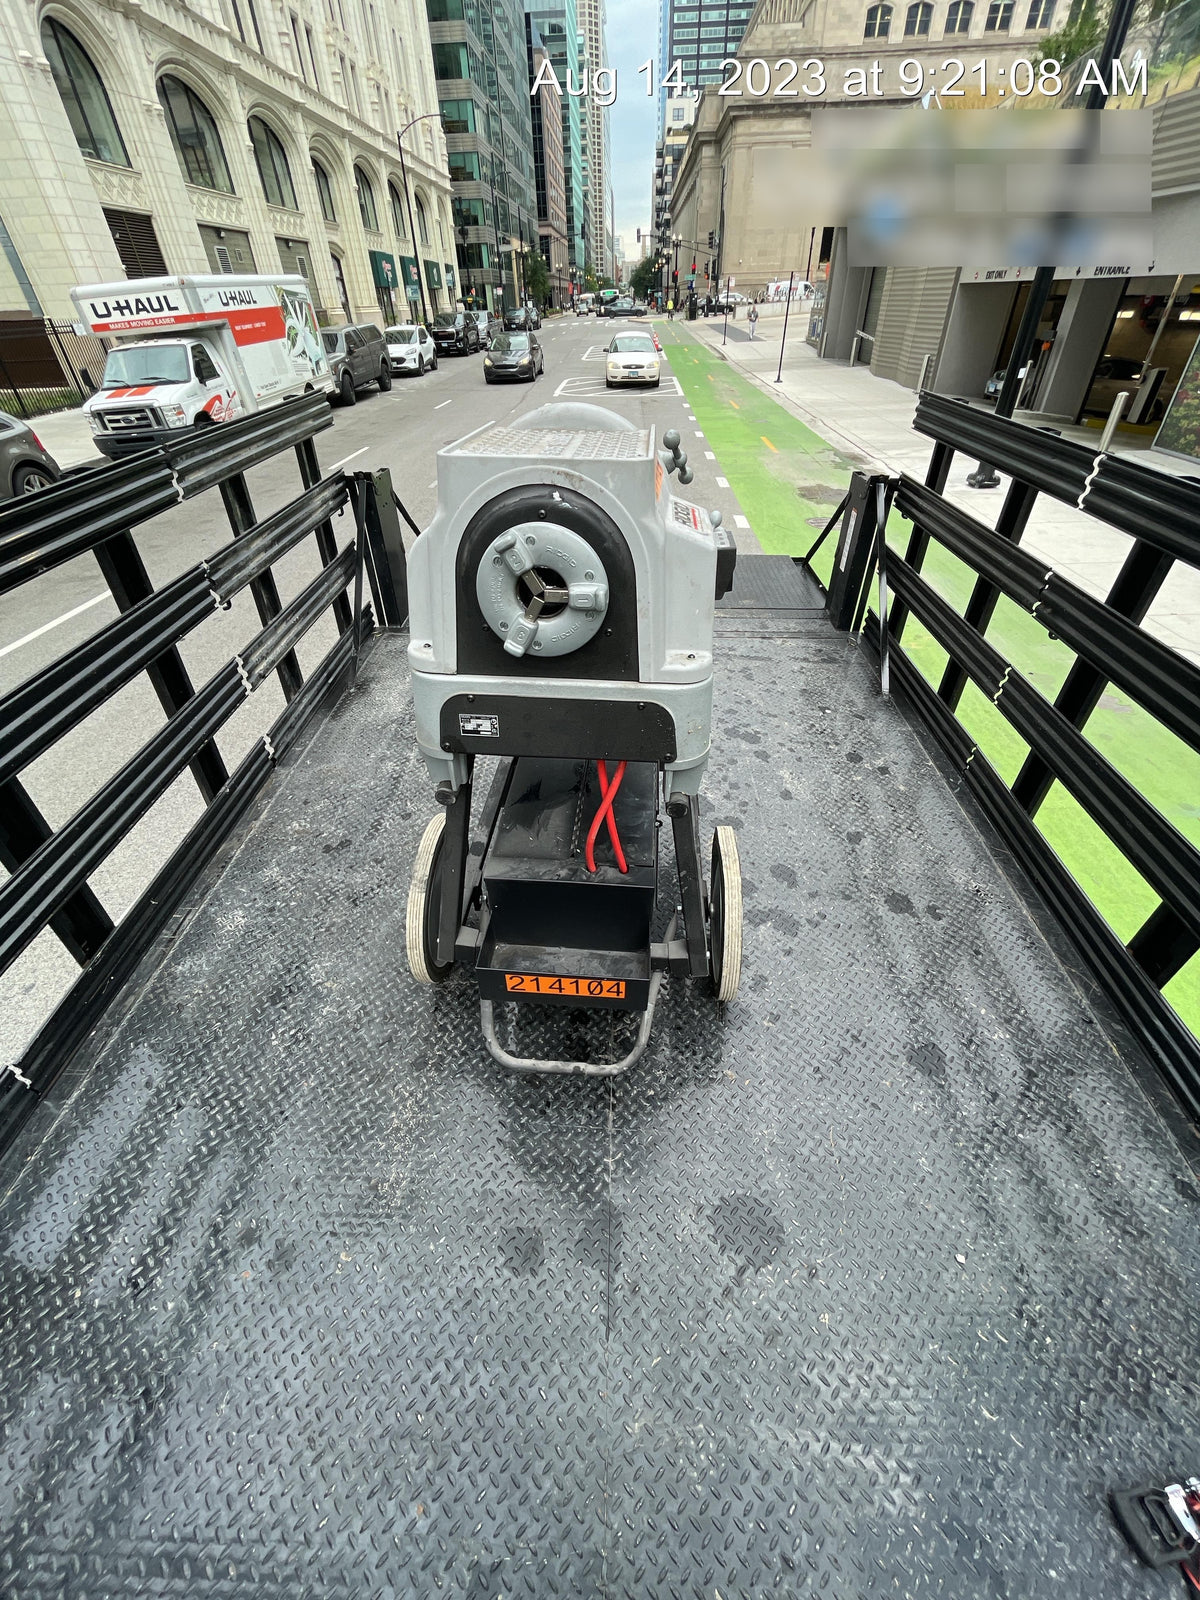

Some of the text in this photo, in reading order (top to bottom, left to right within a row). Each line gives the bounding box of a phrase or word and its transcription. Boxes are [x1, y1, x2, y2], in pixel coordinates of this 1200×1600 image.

[89, 295, 180, 319] U-HAUL
[217, 290, 258, 307] U-HAUL
[108, 317, 176, 330] MAKES MOVING EASIER
[508, 975, 624, 997] 214104
